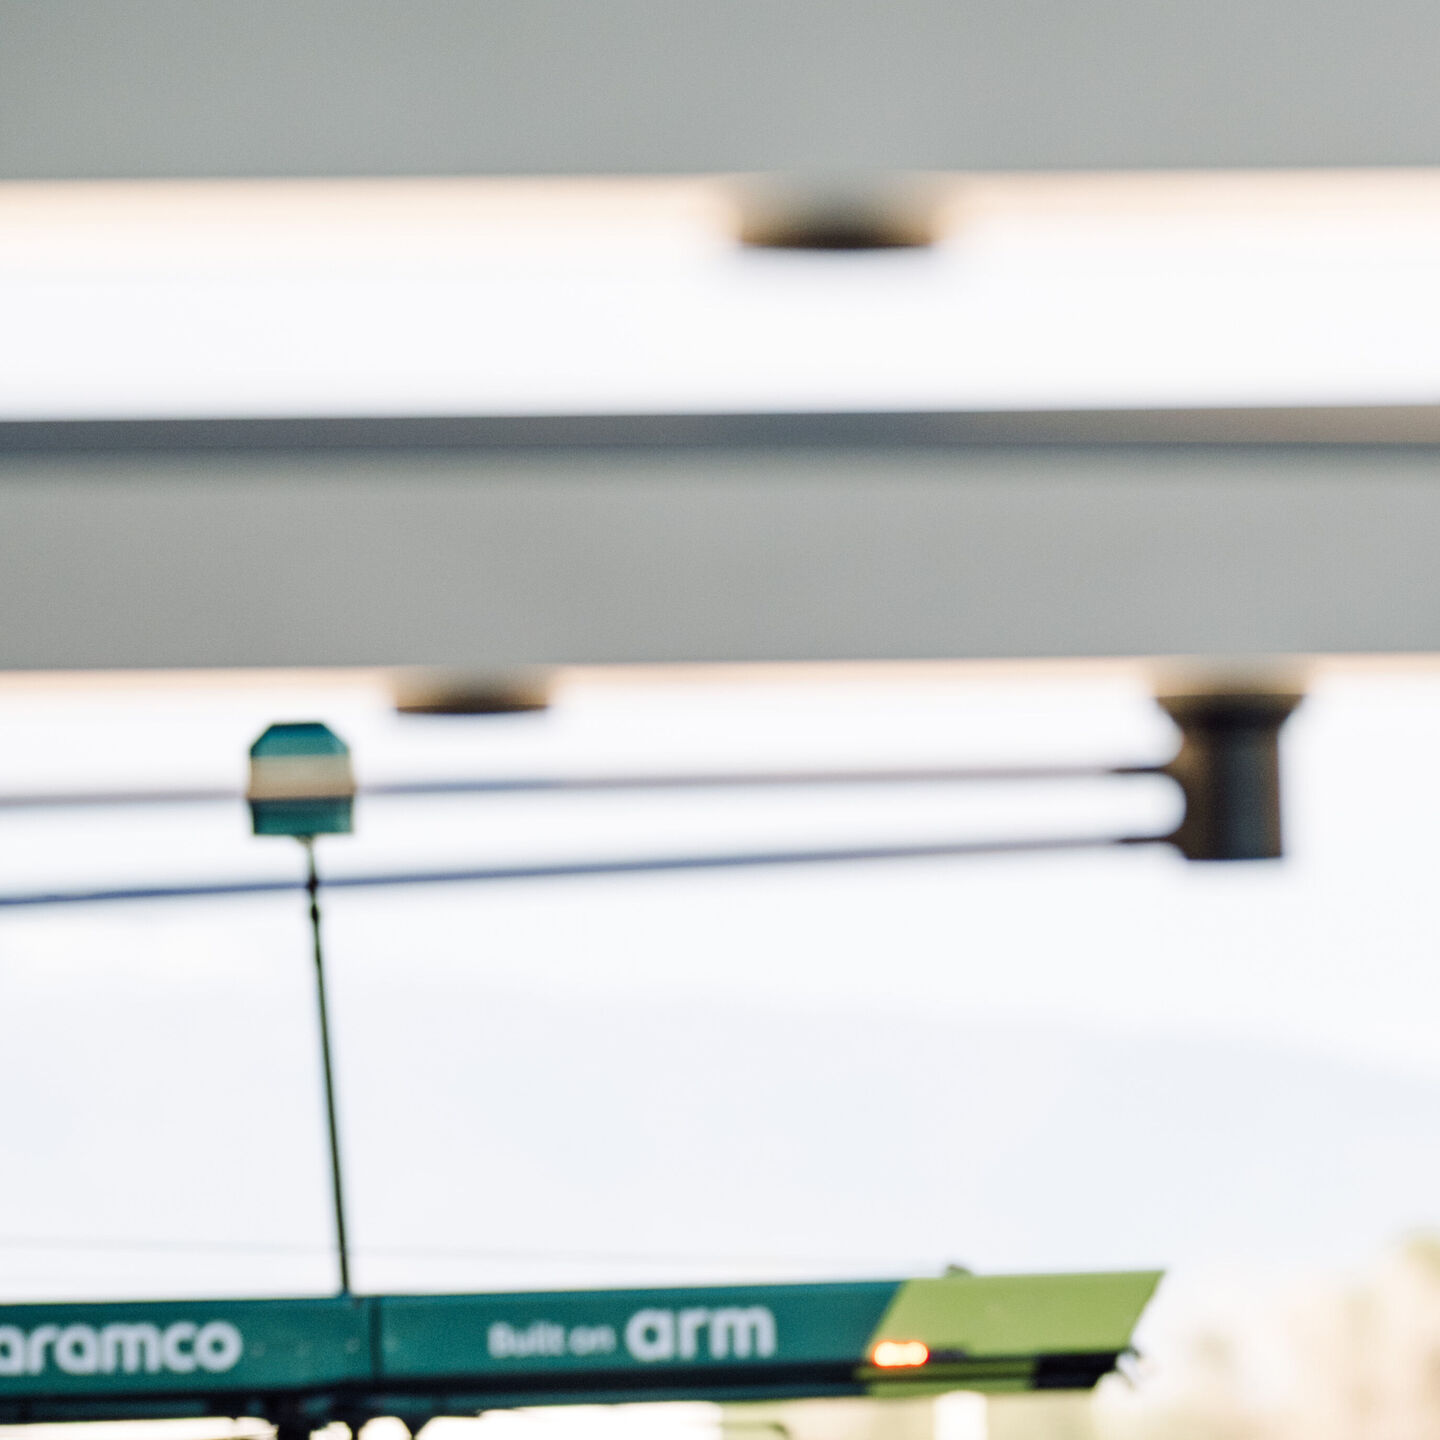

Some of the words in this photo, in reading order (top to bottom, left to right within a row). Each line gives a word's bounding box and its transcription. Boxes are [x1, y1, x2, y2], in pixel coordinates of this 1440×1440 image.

[488, 1320, 567, 1359] Built
[569, 1325, 618, 1356] on
[625, 1306, 779, 1362] arm
